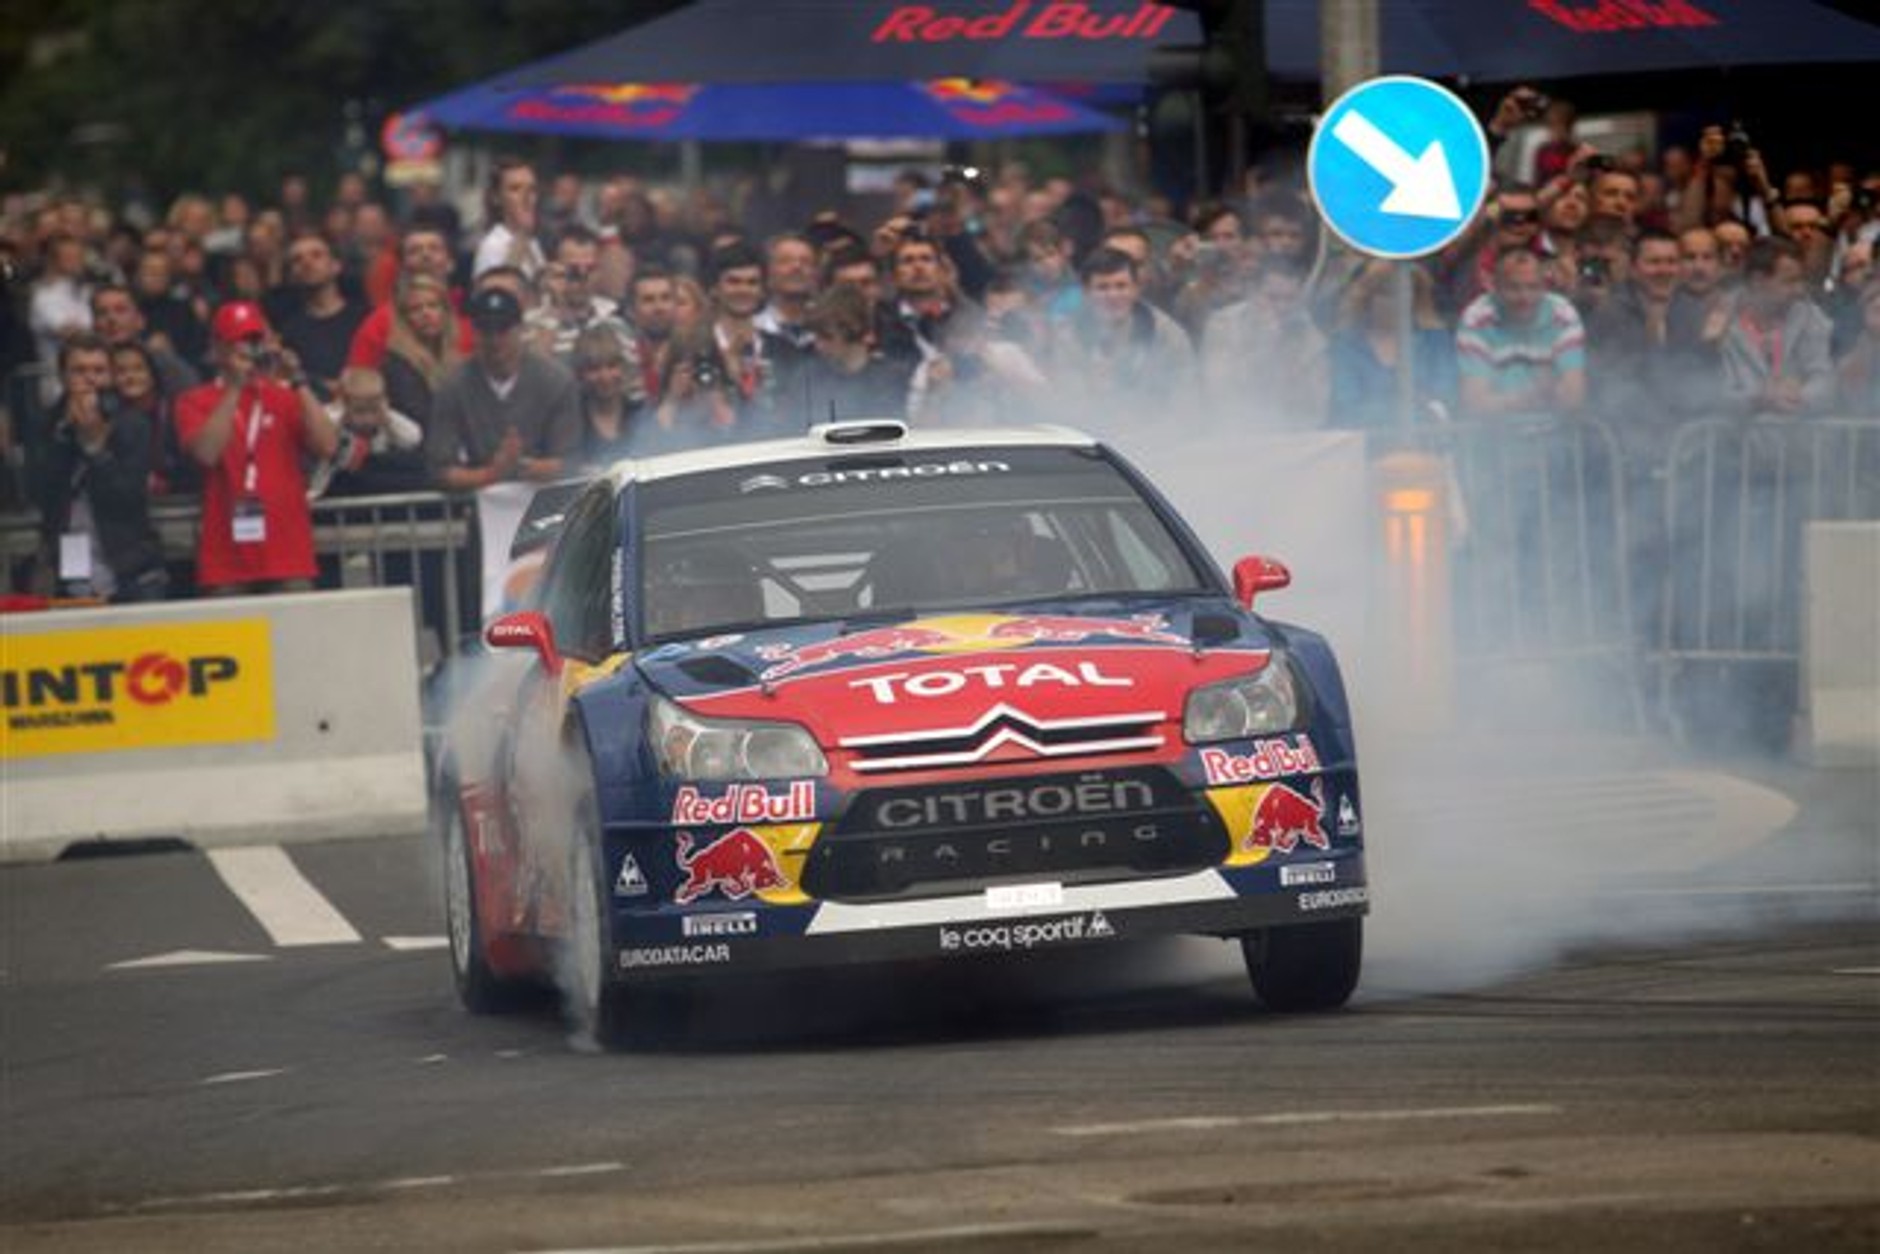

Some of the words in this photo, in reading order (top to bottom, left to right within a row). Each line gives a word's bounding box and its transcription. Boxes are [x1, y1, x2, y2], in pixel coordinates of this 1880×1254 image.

[872, 0, 1028, 42] Red
[1023, 3, 1175, 39] Bull
[848, 661, 1134, 704] TOTAL
[1200, 741, 1274, 786] Red
[673, 784, 738, 825] Red
[738, 780, 816, 823] Bull
[881, 825, 1158, 862] RACING
[682, 913, 757, 937] PIRELLI
[940, 926, 960, 950] le
[963, 926, 1011, 950] coq
[1013, 916, 1083, 947] sportif
[619, 943, 730, 968] EURODATACAR
